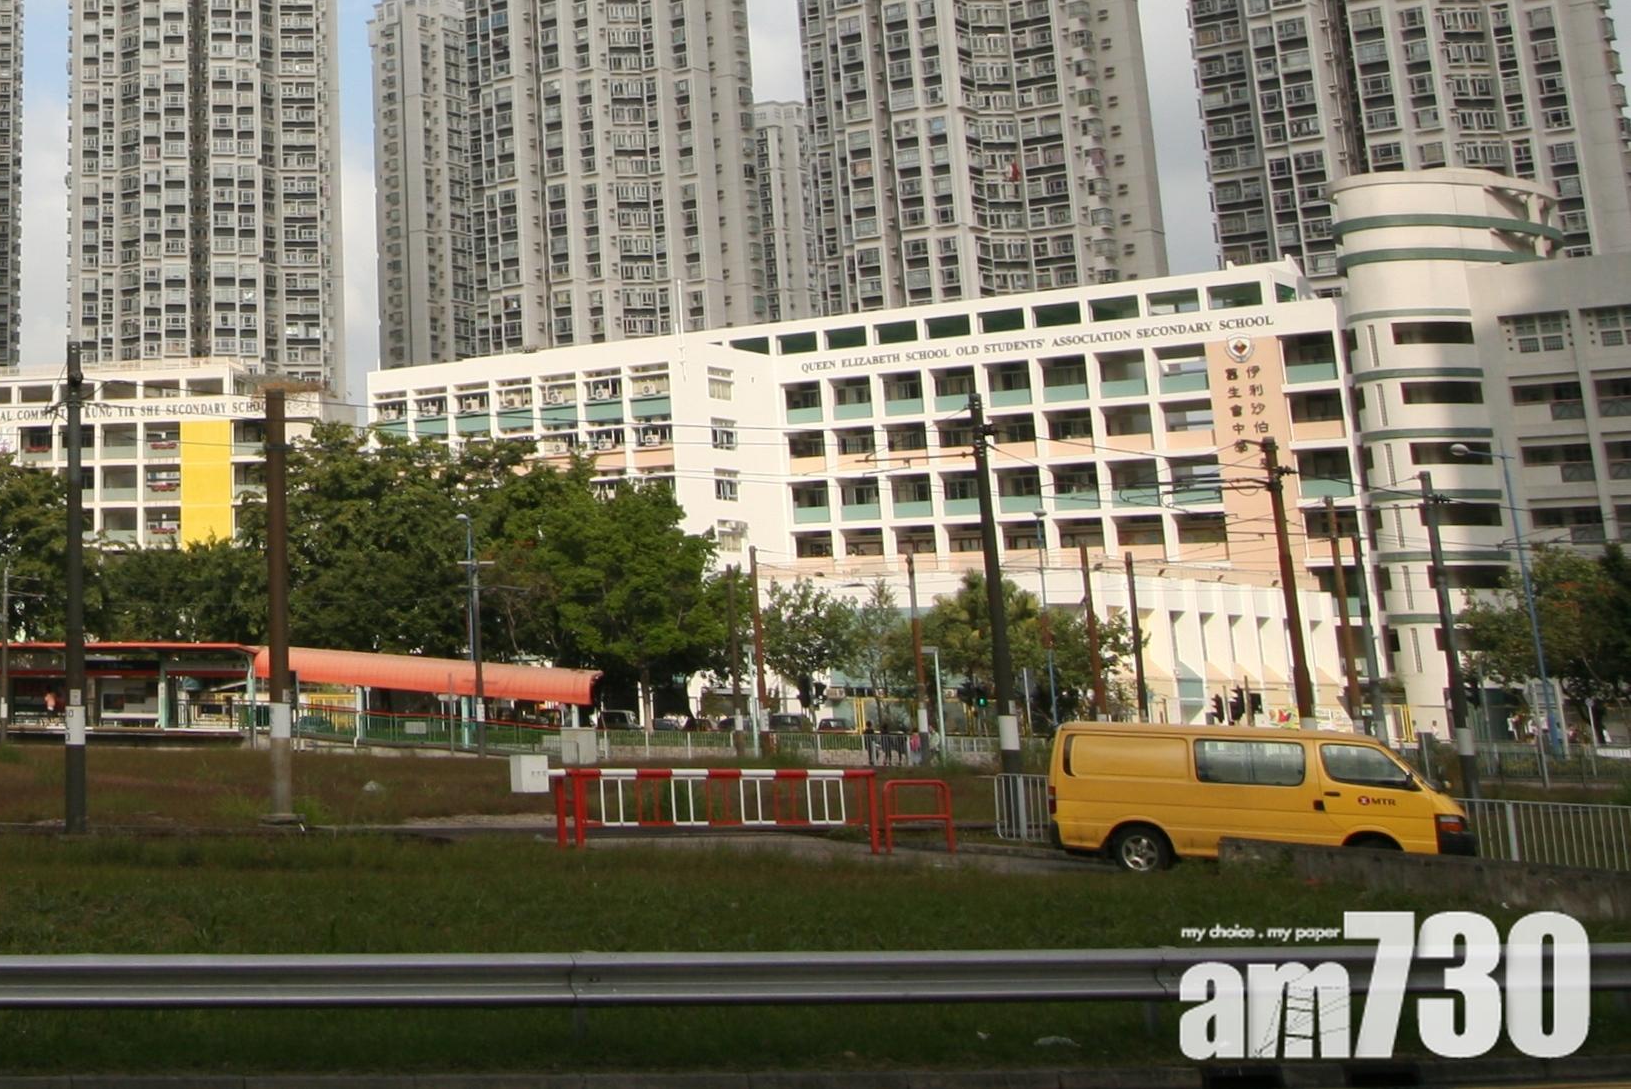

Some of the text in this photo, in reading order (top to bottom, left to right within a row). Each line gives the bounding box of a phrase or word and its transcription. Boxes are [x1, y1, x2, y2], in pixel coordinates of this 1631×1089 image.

[801, 315, 1274, 373] QUEEN ELIZABETH SCHOOL OLD STUDENTS' ASSOCIATION SECONDARY SCHOOL
[85, 406, 112, 418] KUNG
[119, 406, 135, 417] YIK
[140, 405, 160, 416] SHE
[165, 402, 227, 415] SECONDARY
[1371, 797, 1396, 806] MTR
